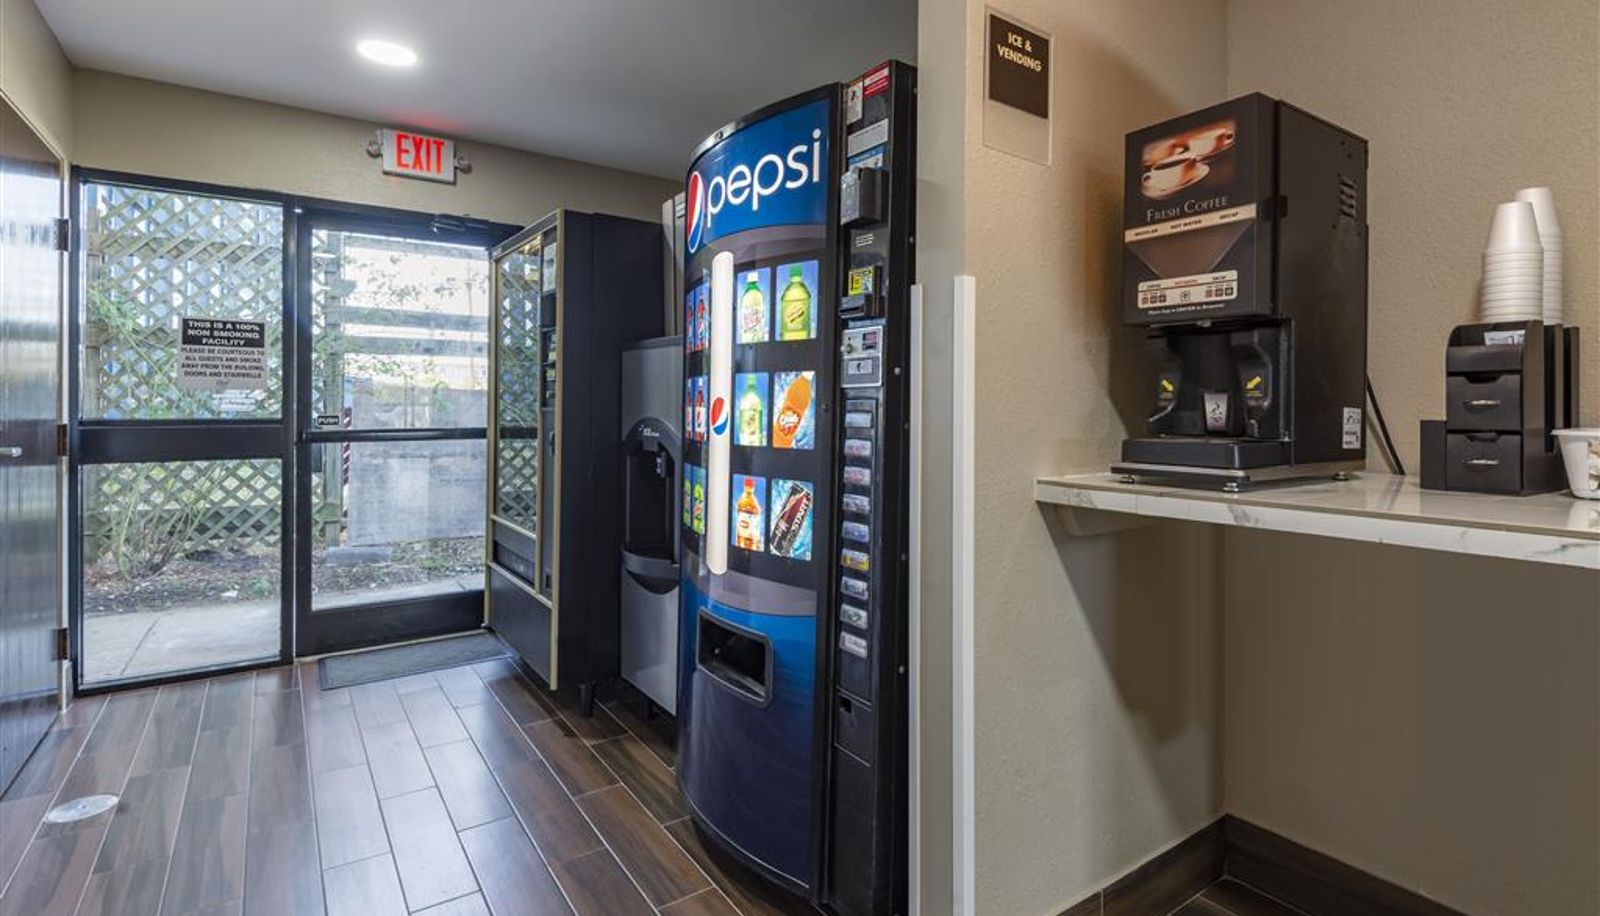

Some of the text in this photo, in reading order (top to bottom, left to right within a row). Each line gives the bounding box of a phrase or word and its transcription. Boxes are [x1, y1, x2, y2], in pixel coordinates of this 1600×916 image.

[1007, 32, 1032, 53] ICE &
[997, 44, 1042, 72] VENDING
[396, 132, 445, 176] EXIT
[707, 128, 822, 228] pepsi
[187, 320, 260, 332] THIS IS A 100%
[187, 328, 260, 339] NON SMOKING
[202, 337, 246, 347] FACILITY
[318, 417, 339, 425] PUSH
